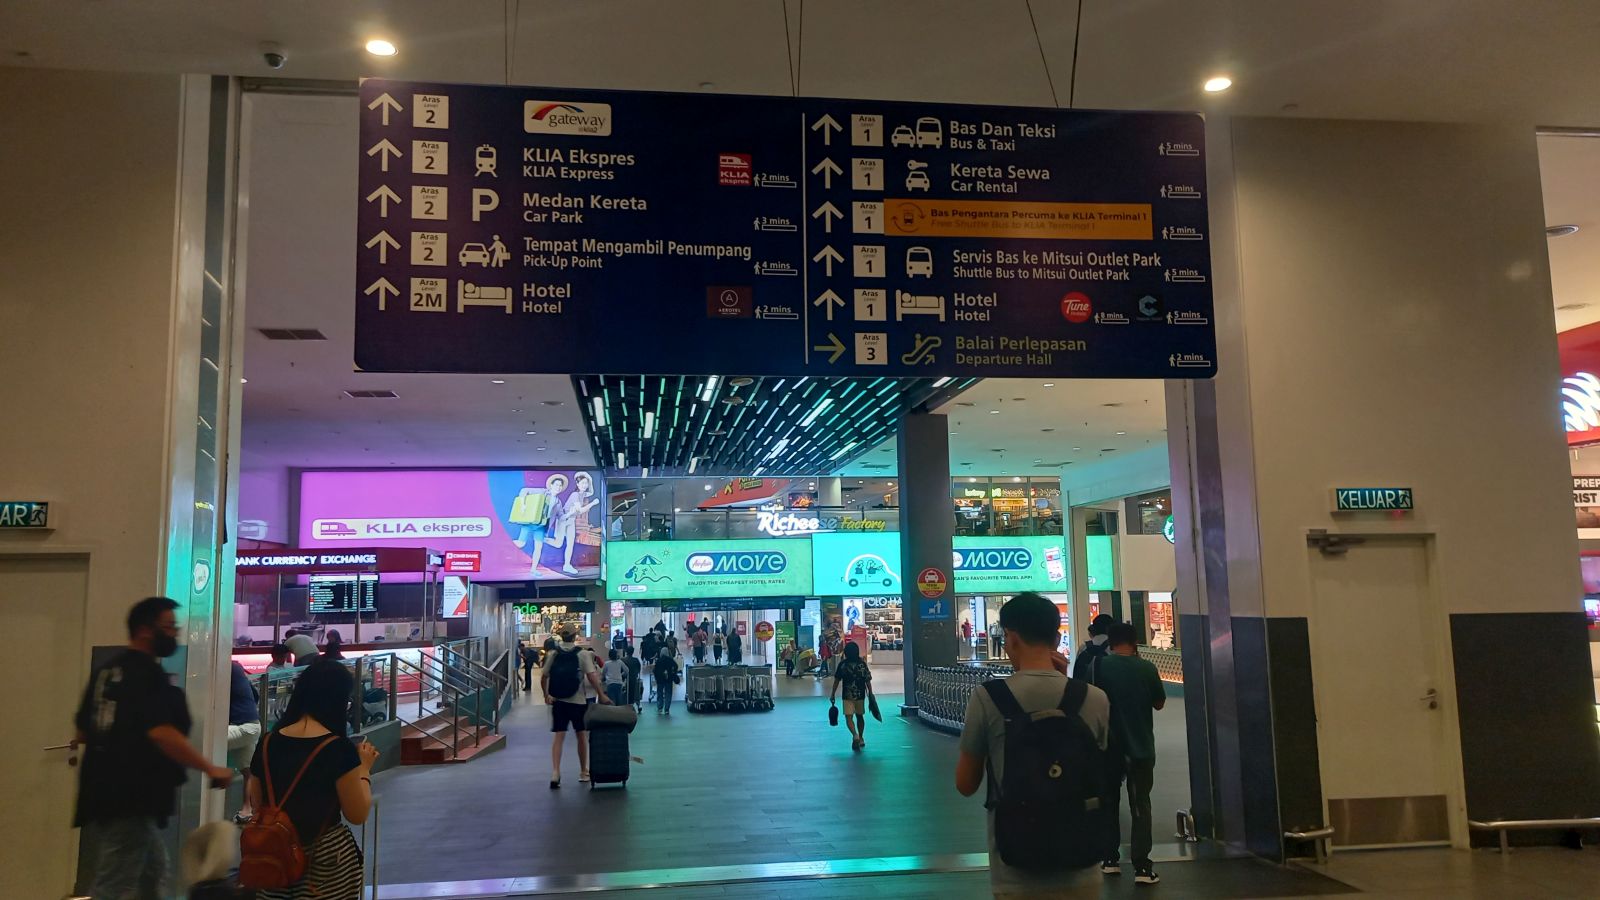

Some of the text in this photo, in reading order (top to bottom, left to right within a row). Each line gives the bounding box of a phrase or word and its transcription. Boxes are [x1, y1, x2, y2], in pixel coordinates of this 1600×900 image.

[426, 110, 436, 124] 2
[549, 114, 606, 128] gateway
[864, 129, 870, 142] 1
[950, 121, 1056, 138] Bas Dan Teksi
[950, 138, 1016, 151] Bus & Taxi
[424, 156, 435, 169] 2
[523, 148, 635, 168] KLIA Ekspres
[523, 166, 614, 181] KLIA Express
[769, 174, 789, 182] mins
[951, 163, 1050, 180] Kereta Sewa
[864, 173, 870, 186] 1
[952, 180, 1018, 193] Car Rental
[424, 202, 434, 215] 2
[472, 188, 500, 221] P
[523, 193, 647, 210] Medan Kereta
[523, 211, 583, 223] Car Park
[931, 209, 949, 217] Bas
[952, 209, 1009, 219] Pengantara
[1012, 211, 1055, 219] Percuma
[1098, 213, 1142, 221] Terminal
[865, 216, 871, 229] 1
[424, 248, 434, 261] 2
[524, 237, 751, 260] Tempat Mengambil Penumpang
[524, 255, 603, 270] Pick-Up Point
[953, 249, 1161, 267] Servis Bas ke Mitsui Outlet Park
[866, 260, 872, 273] 1
[953, 266, 1130, 281] Shuttle Bus to Mitsui Outlet Park
[523, 283, 570, 298] Hotel
[414, 293, 442, 307] 2M
[954, 292, 997, 307] Hotel
[522, 301, 561, 313] Hotel
[867, 304, 873, 316] 1
[1063, 300, 1089, 314] Tune
[955, 310, 990, 321] Hotel
[956, 336, 1086, 353] Balai Perlepasan
[867, 348, 875, 361] 3
[956, 353, 1052, 367] Departure Hall
[1338, 490, 1396, 508] KELUAR
[0, 505, 27, 526] AR
[366, 522, 484, 534] KLIA ekspres
[757, 512, 886, 536] Richeese Factory
[262, 556, 317, 565] CURRENCY
[321, 554, 376, 564] EXCHANGE
[863, 597, 887, 606] POLO
